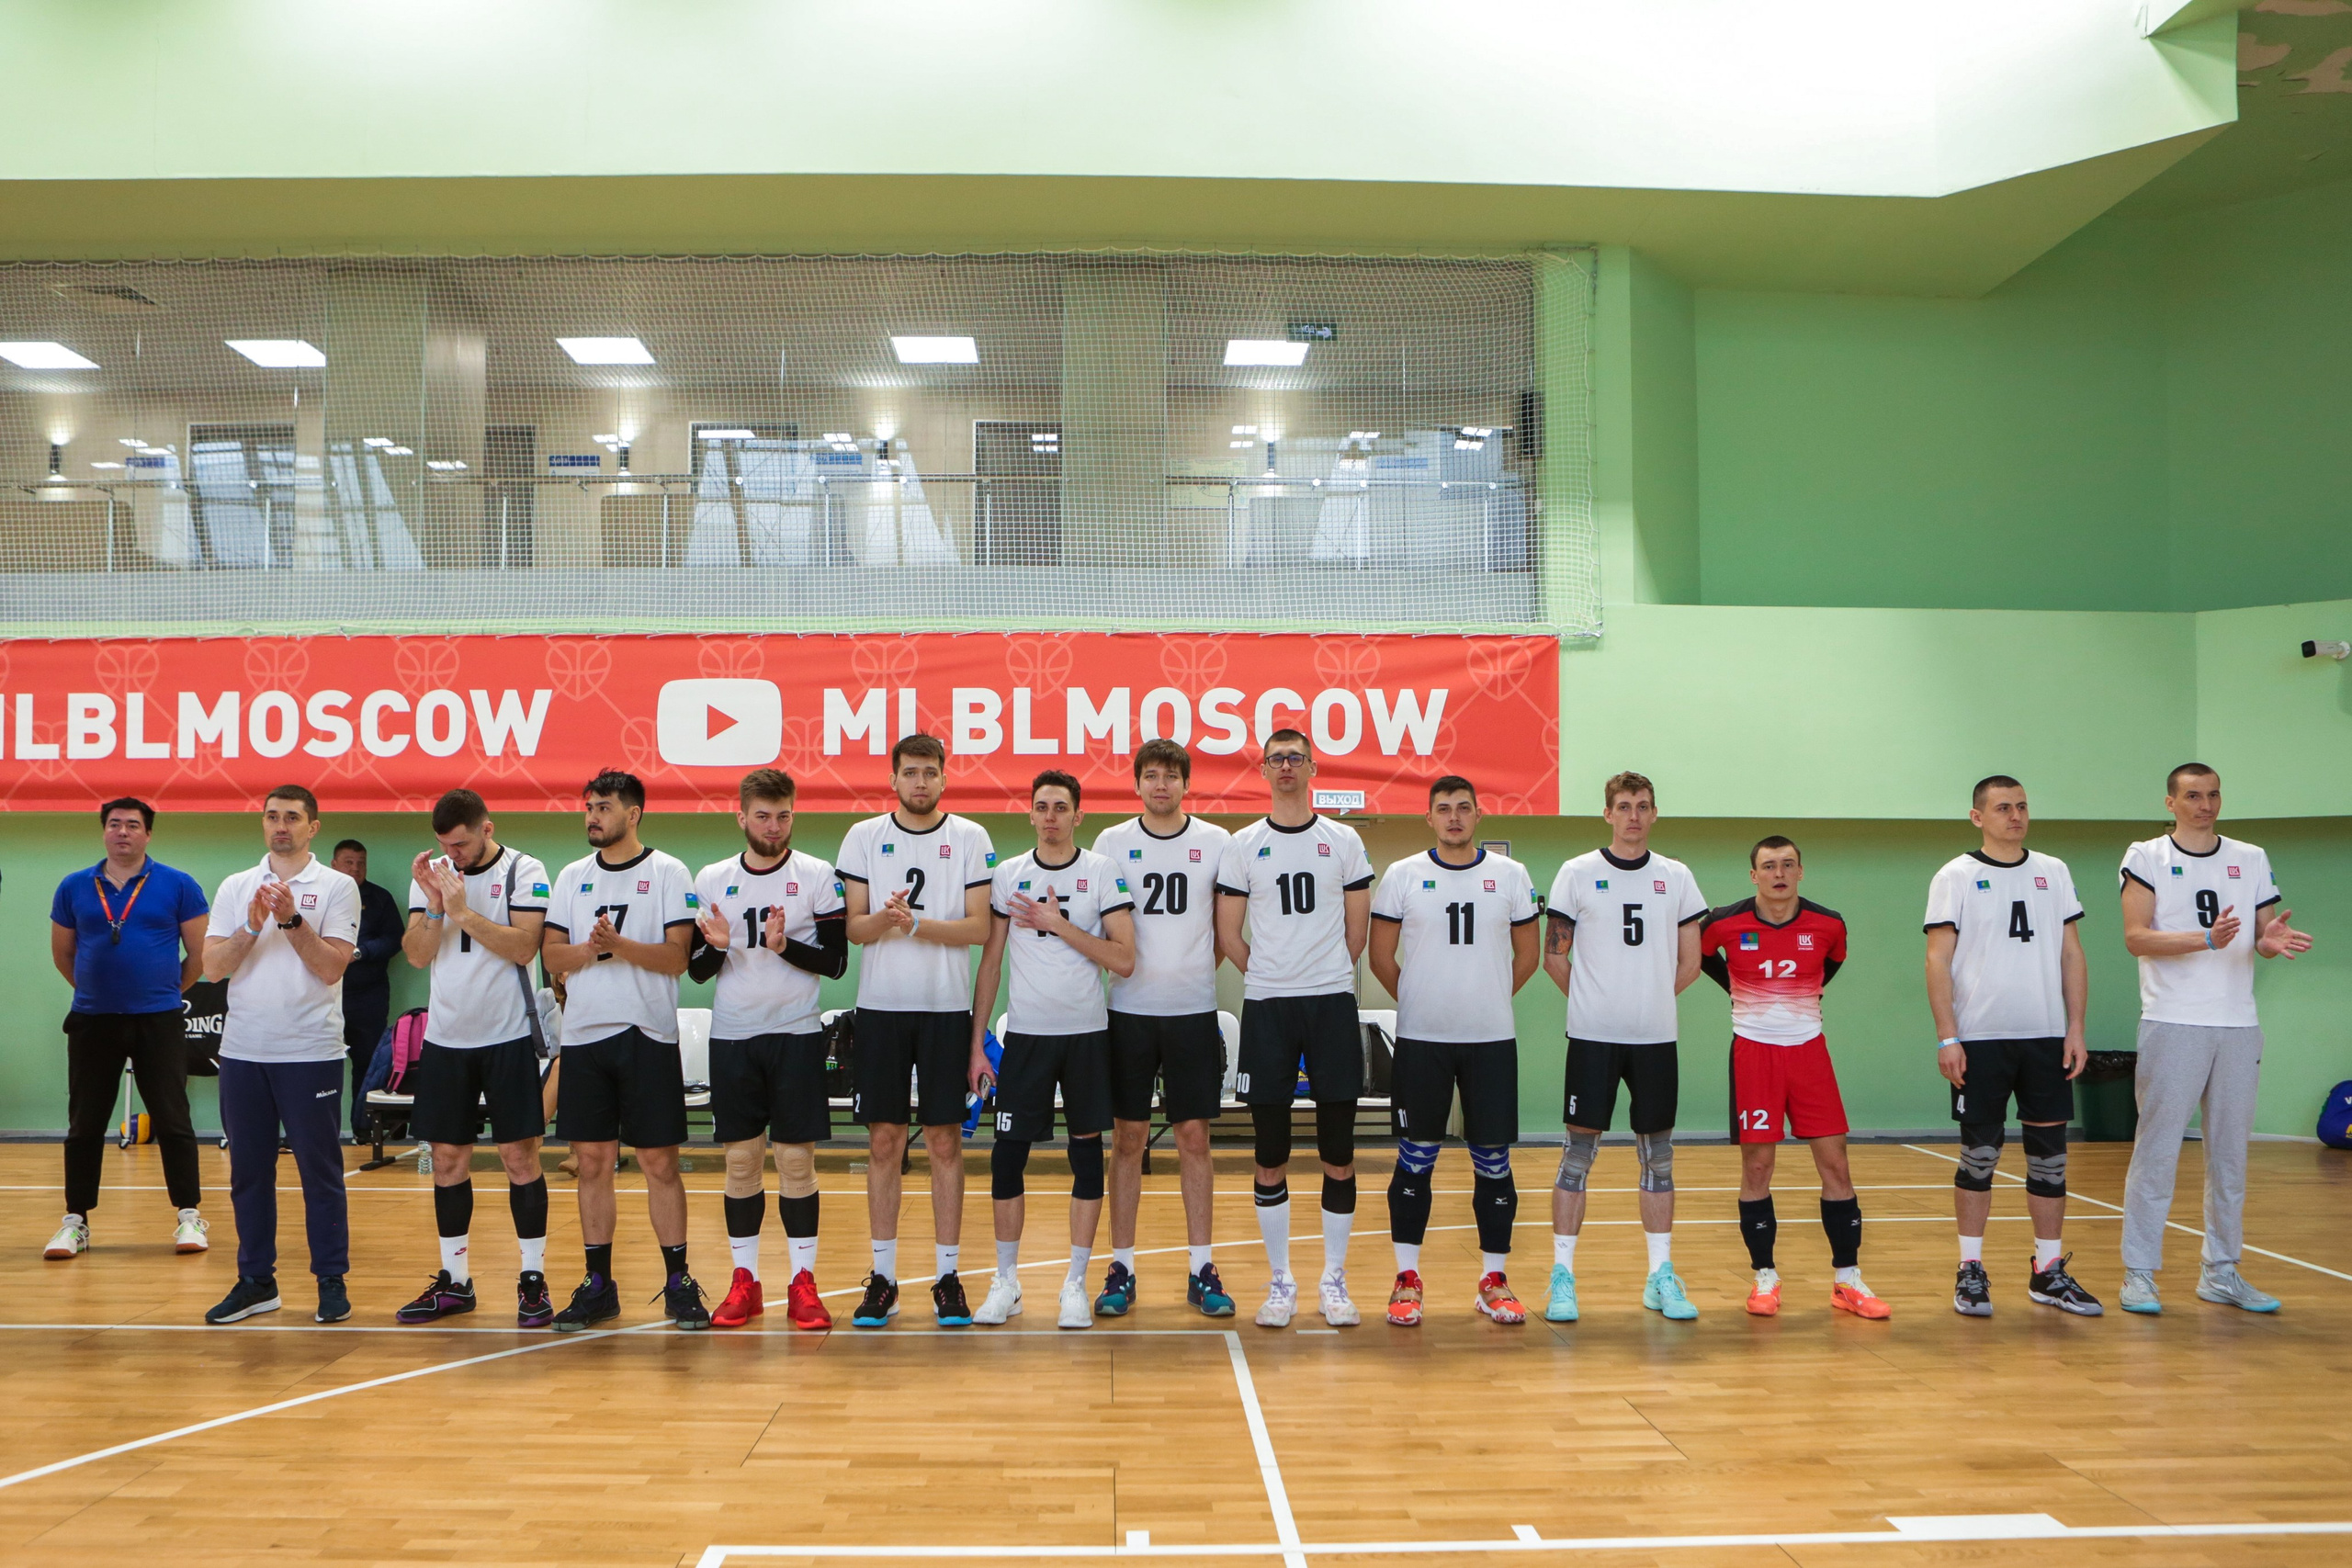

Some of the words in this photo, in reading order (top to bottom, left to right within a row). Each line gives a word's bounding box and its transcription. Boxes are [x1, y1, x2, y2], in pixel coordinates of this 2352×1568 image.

[0, 689, 553, 760] LBLMOSCOW
[1318, 795, 1360, 805] ВЫХОД
[906, 868, 925, 910] 2
[1144, 873, 1187, 914] 20
[1276, 873, 1316, 915] 10
[2196, 890, 2219, 929] 9
[1445, 903, 1475, 944] 11
[1623, 904, 1643, 946] 5
[2009, 901, 2034, 942] 4
[1758, 960, 1797, 978] 12
[1237, 1073, 1250, 1093] 10
[854, 1093, 861, 1113] 2
[1569, 1095, 1577, 1115] 5
[1956, 1094, 1966, 1114] 4
[996, 1111, 1012, 1132] 15
[1397, 1108, 1408, 1128] 11
[1739, 1110, 1770, 1130] 12
